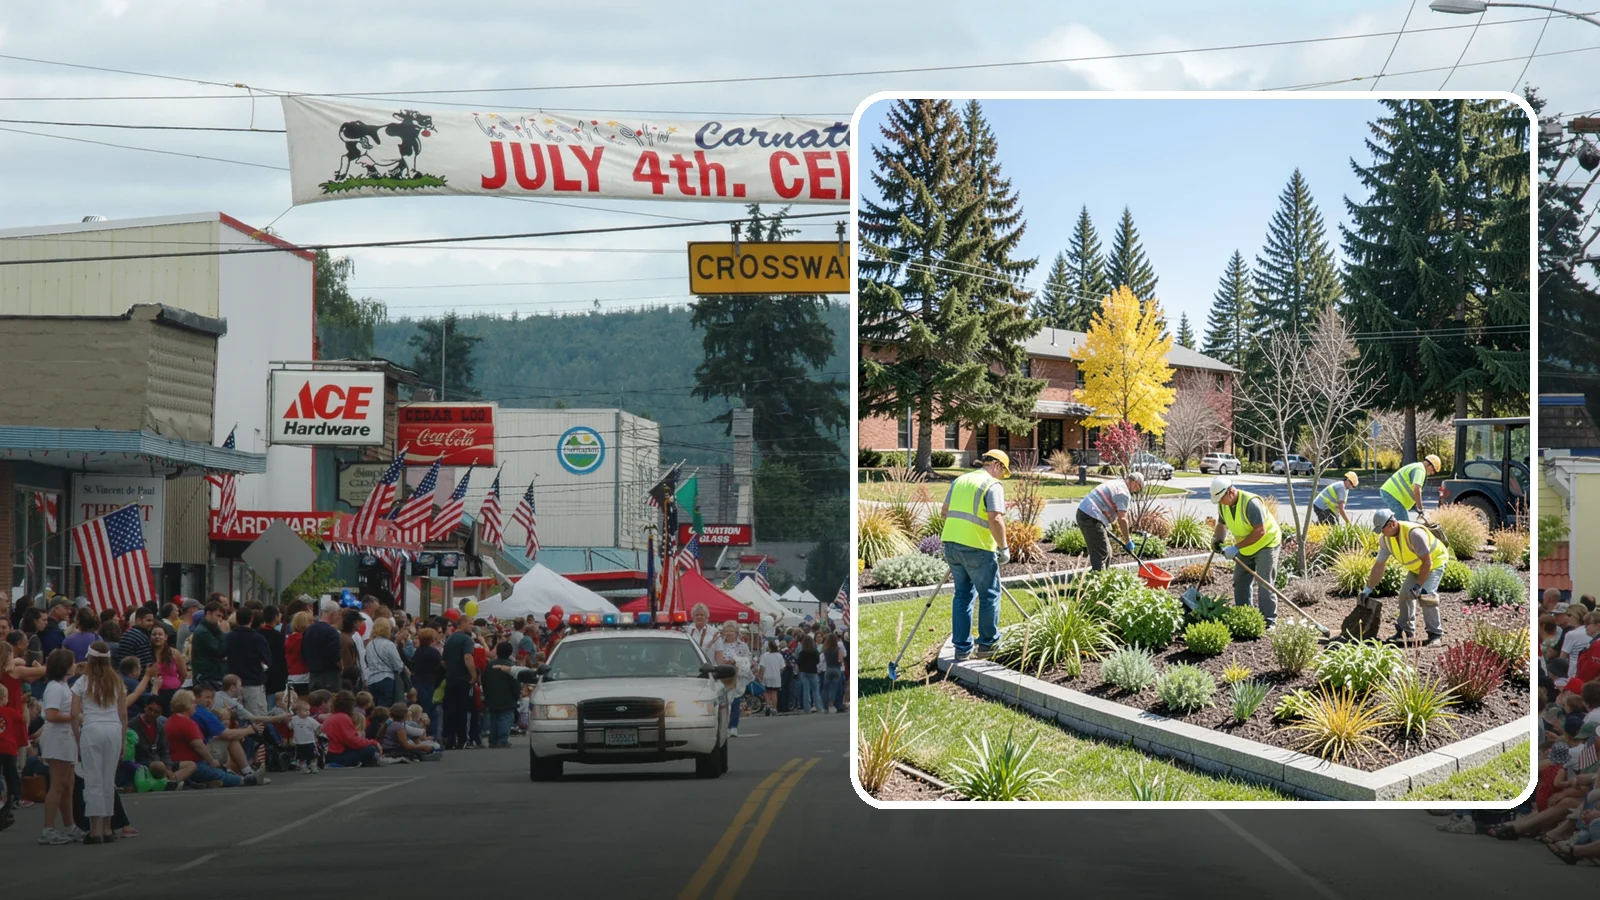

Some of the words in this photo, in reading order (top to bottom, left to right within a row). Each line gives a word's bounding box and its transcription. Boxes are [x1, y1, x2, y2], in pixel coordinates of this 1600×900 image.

[695, 121, 850, 149] Carnat
[481, 141, 605, 192] JULY
[632, 150, 746, 197] 4th.
[697, 254, 850, 280] CROSSWA
[283, 380, 373, 420] ACE
[406, 409, 452, 422] CEDAR
[283, 421, 371, 436] Hardware
[96, 485, 124, 494] Vincent
[126, 486, 135, 494] de
[138, 486, 155, 495] Paul
[688, 526, 742, 535] CRNATION
[699, 535, 730, 543] GLASS
